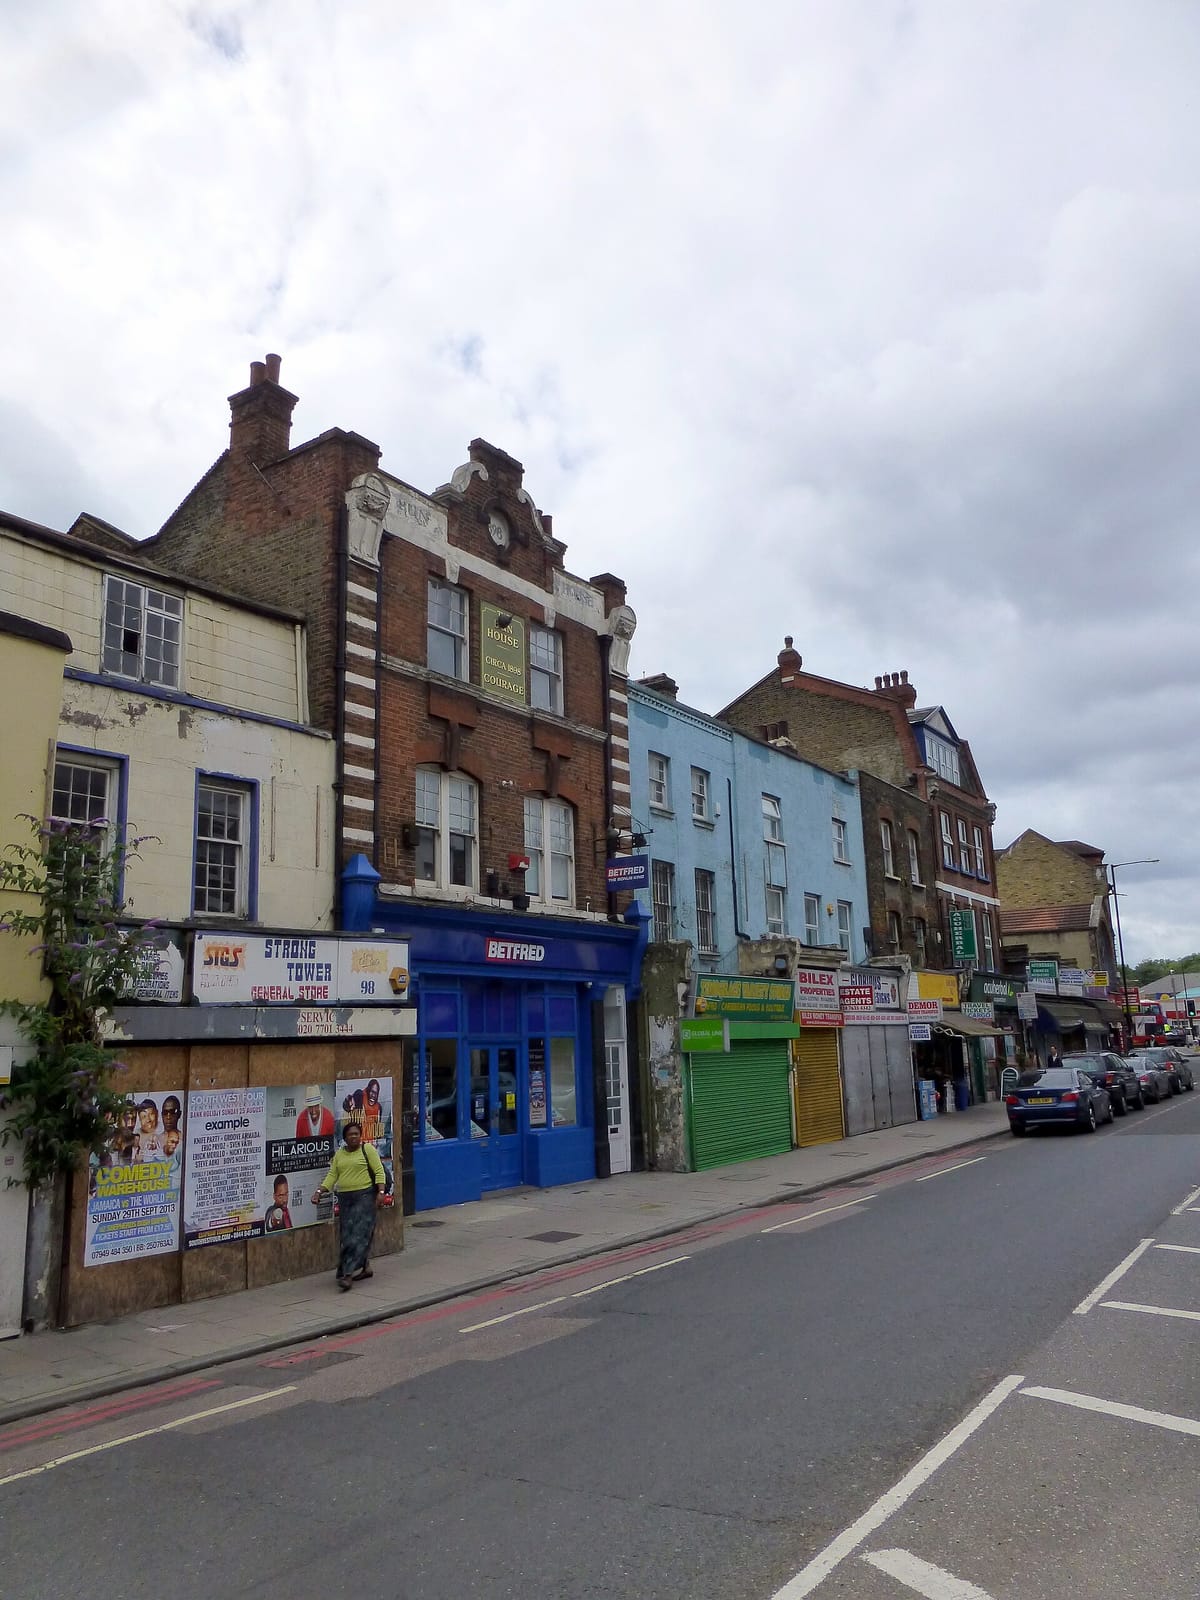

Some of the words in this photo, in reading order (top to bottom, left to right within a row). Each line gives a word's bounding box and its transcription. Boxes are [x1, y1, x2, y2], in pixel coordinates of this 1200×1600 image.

[487, 627, 519, 649] HOUSE
[485, 655, 506, 671] CIRCA
[484, 673, 525, 695] COURAGE
[608, 865, 645, 878] BETFRED
[265, 939, 316, 959] STRONG
[487, 940, 545, 962] BETFRED
[287, 963, 332, 981] TOWER
[799, 972, 834, 986] BILEX
[137, 989, 162, 998] GENERAL
[165, 990, 179, 999] ITEMS
[251, 985, 295, 1000] GENERAL
[299, 986, 329, 1000] STORE
[360, 980, 375, 995] 98
[800, 987, 836, 997] PROPERTIES
[840, 988, 871, 996] ESTATE
[840, 997, 872, 1005] AGENTS
[908, 1001, 938, 1010] DEMOR
[315, 1024, 332, 1034] 7701
[191, 1095, 217, 1105] SOUTH
[220, 1093, 240, 1103] WEST
[243, 1092, 264, 1100] FOUR
[221, 1108, 239, 1116] SUNDAY
[246, 1106, 264, 1114] AUGUST
[205, 1117, 250, 1131] example
[271, 1140, 330, 1158] HILARIOUS
[96, 1161, 172, 1185] COMEDY
[97, 1178, 171, 1197] WAREHOUSE
[90, 1200, 121, 1213] JAMAICA
[130, 1196, 143, 1206] THE
[145, 1193, 165, 1204] WORLD
[92, 1211, 121, 1223] SUNDAY
[122, 1209, 140, 1219] 29TH
[141, 1207, 157, 1216] SEPT
[159, 1204, 176, 1213] 2013
[95, 1231, 119, 1241] TICKETS
[119, 1228, 137, 1238] START
[137, 1226, 153, 1235] FROM
[91, 1250, 110, 1260] 07949
